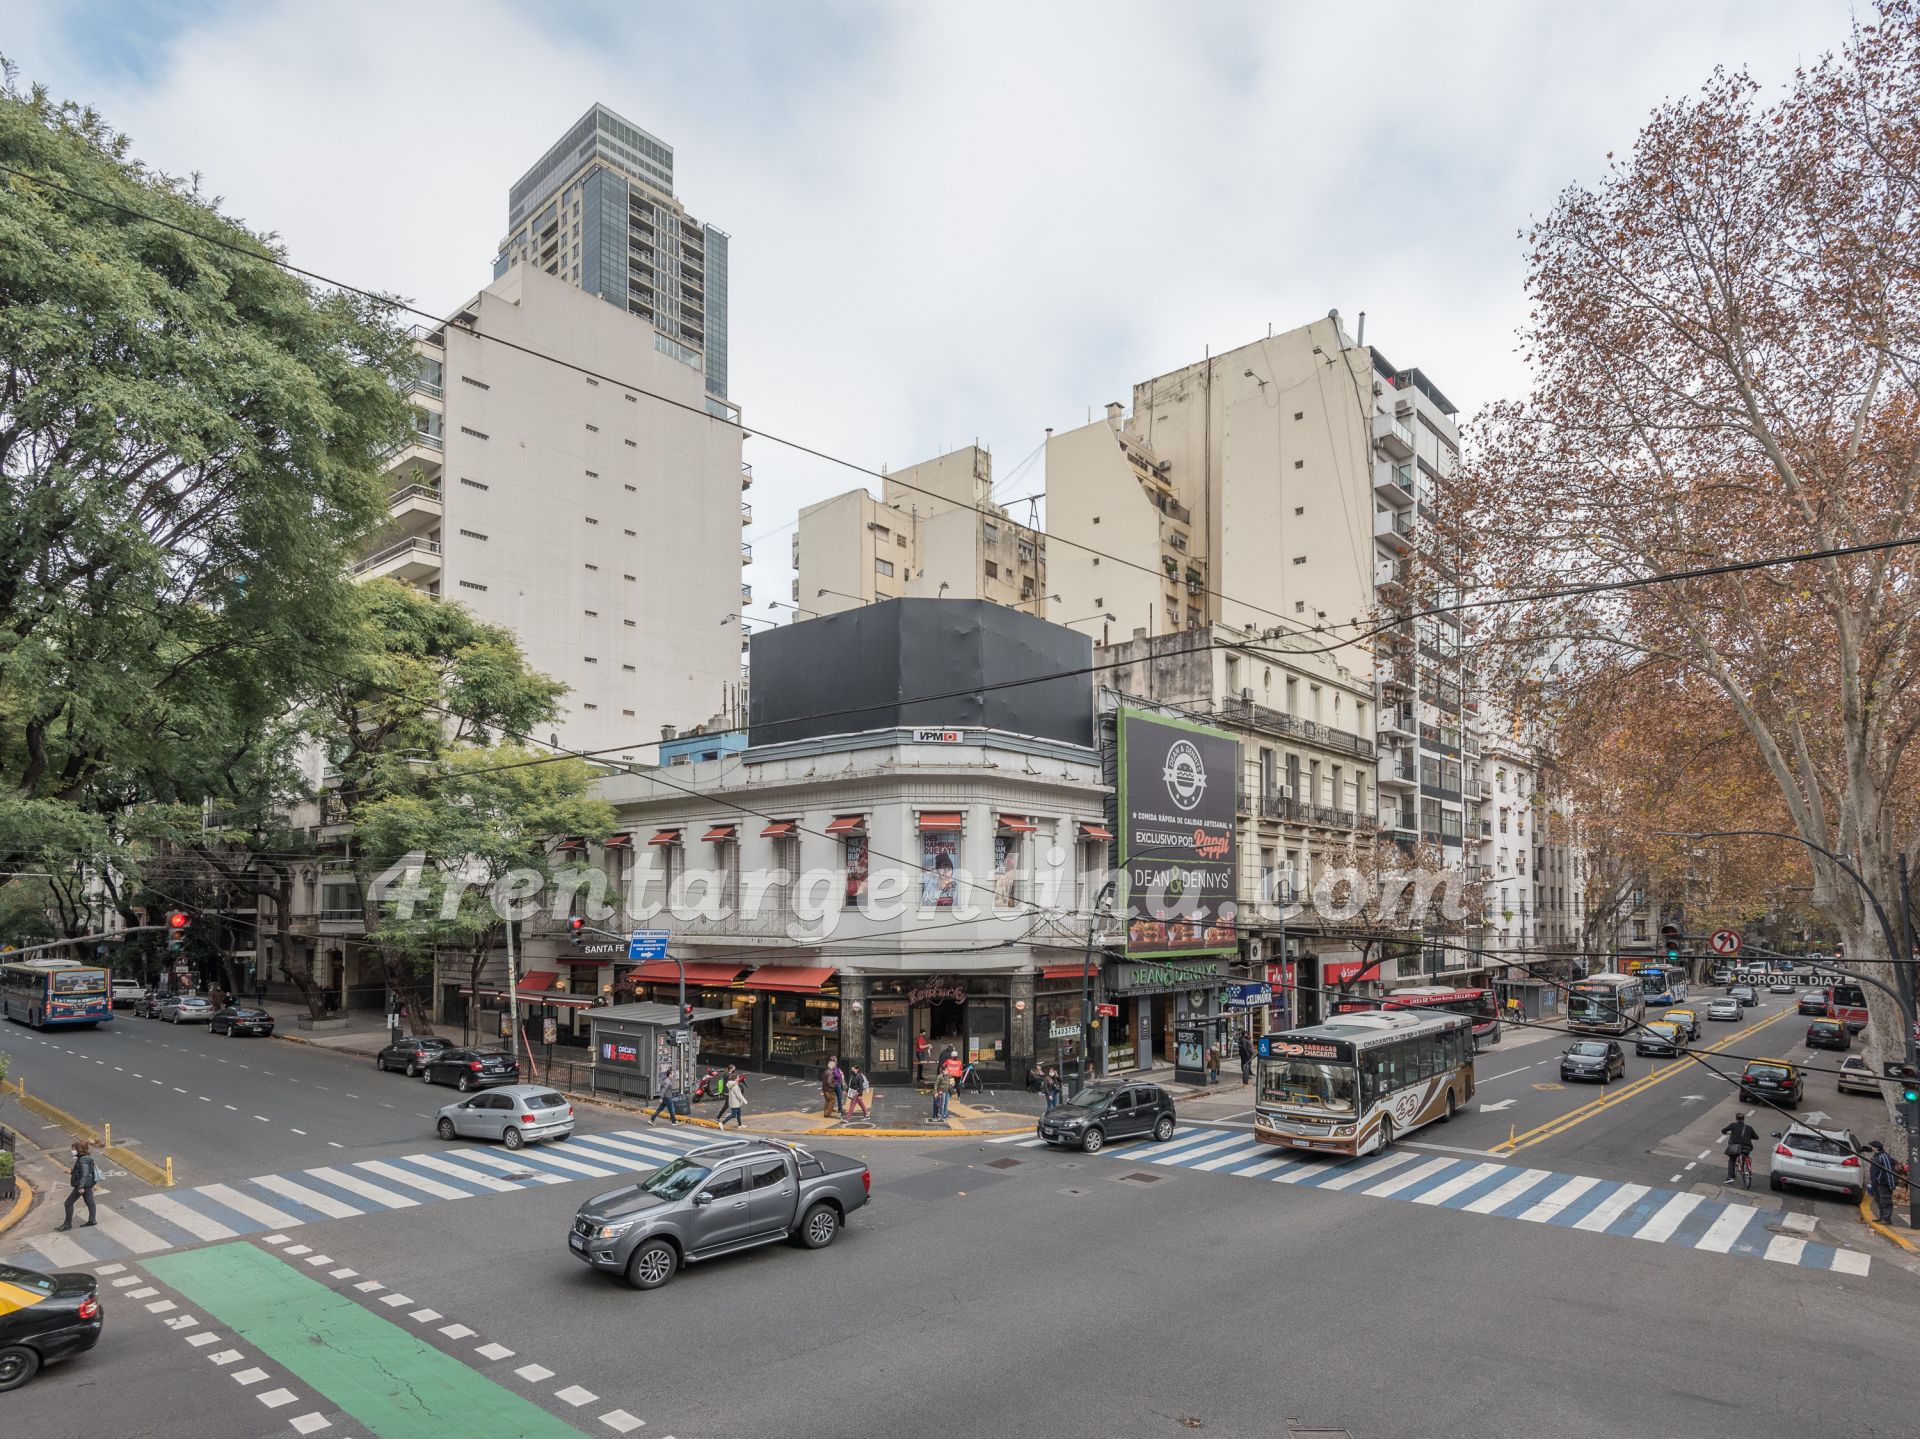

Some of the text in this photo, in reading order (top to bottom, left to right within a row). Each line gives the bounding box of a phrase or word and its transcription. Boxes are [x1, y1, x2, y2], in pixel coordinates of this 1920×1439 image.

[920, 731, 943, 741] VPM
[1169, 746, 1180, 767] DEAN
[1138, 812, 1157, 821] COMIDA
[1158, 813, 1176, 823] RÁPIDA
[1184, 818, 1202, 827] CALIDAD
[1204, 820, 1228, 829] ARTESANAL
[1136, 832, 1193, 847] EXCLUSIVO POR
[1194, 829, 1230, 859] Rappi
[1135, 865, 1228, 893] DEAN & DENNYS
[585, 945, 613, 954] SANTA
[615, 944, 625, 952] FE
[1131, 968, 1163, 985] DEAN
[1738, 974, 1844, 987] CORONEL DIAZ
[1338, 1004, 1351, 1012] 12
[1271, 1042, 1304, 1055] 39
[1304, 1044, 1337, 1053] BARRACAS
[1363, 1036, 1394, 1048] CHACARITA
[1304, 1050, 1337, 1059] CHACARITA
